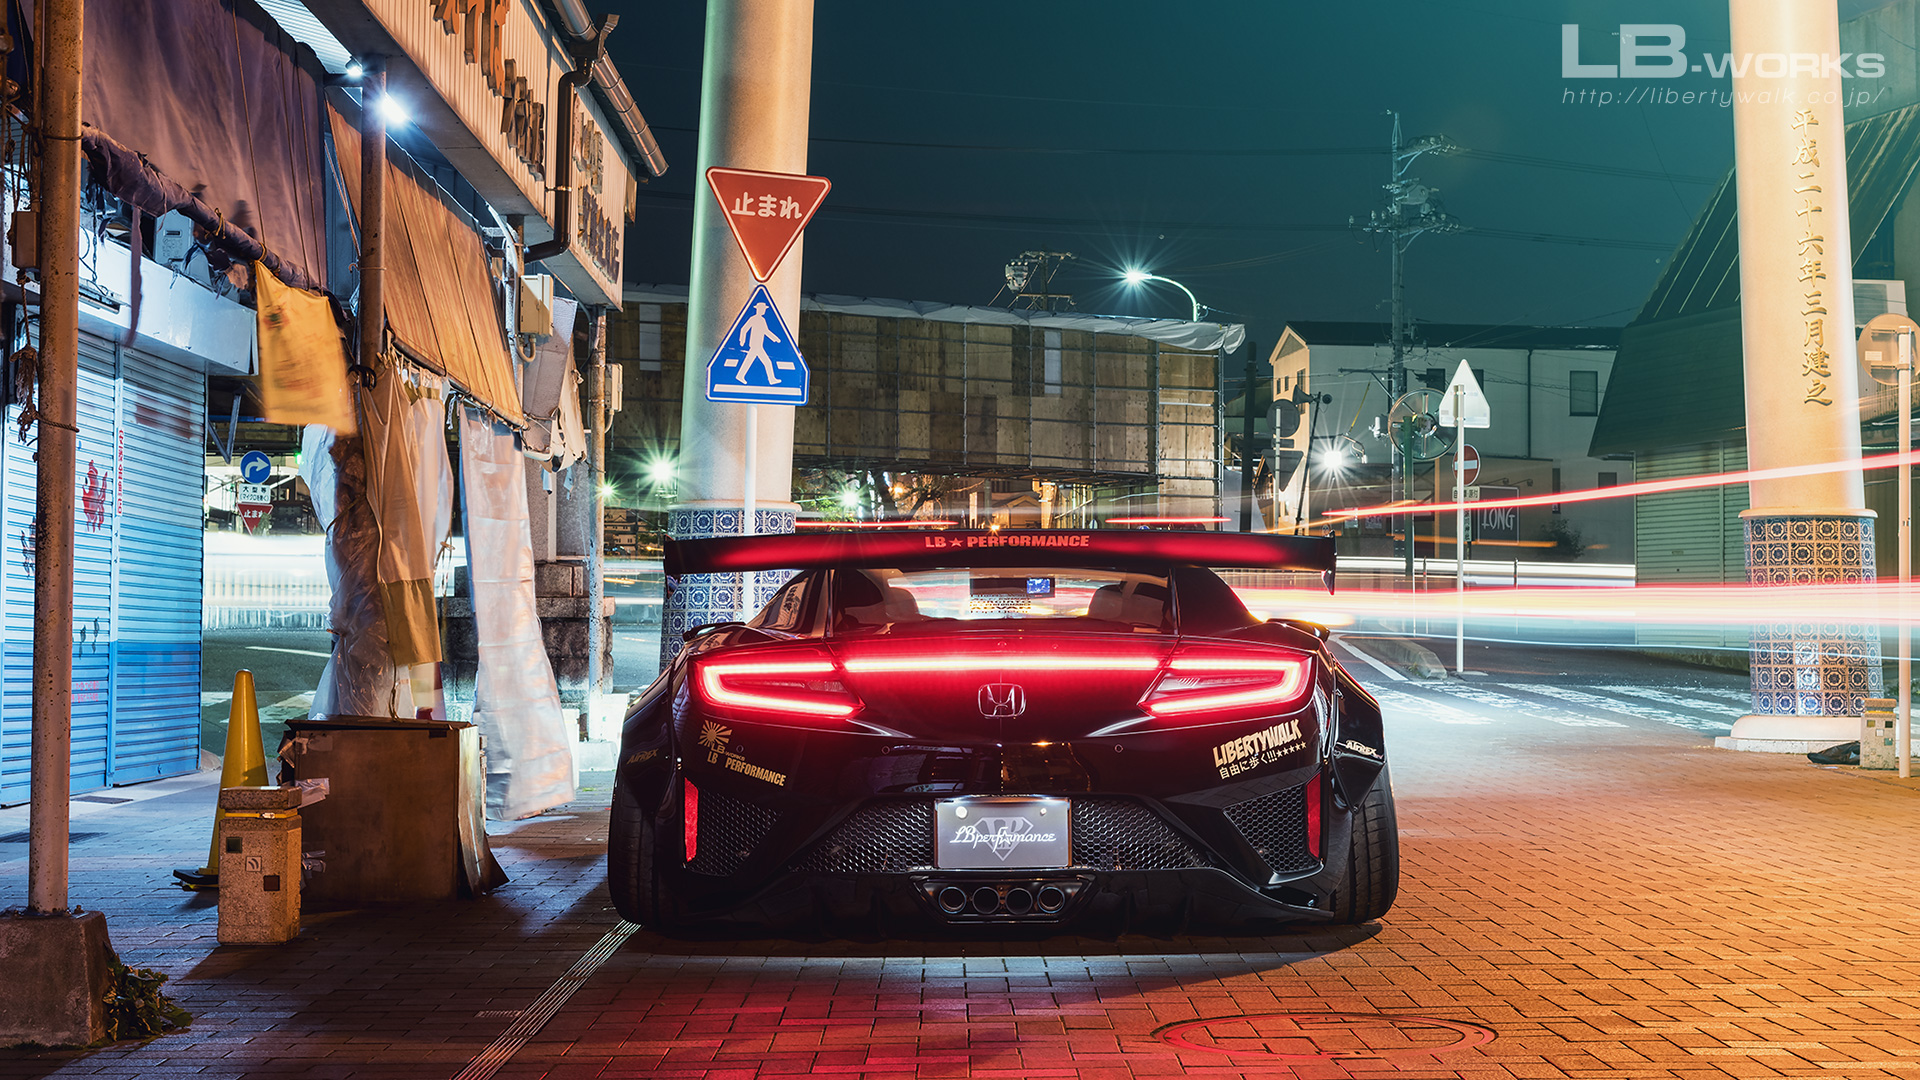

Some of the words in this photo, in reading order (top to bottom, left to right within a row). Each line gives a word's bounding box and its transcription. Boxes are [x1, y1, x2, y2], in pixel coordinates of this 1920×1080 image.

[731, 191, 803, 219] 止まれ
[1791, 109, 1833, 406] 平成二十六年三月建之
[925, 537, 947, 548] LB
[967, 535, 1090, 548] PERFORMANCE
[1212, 719, 1303, 768] LIBERTYWALK
[707, 751, 719, 764] LB
[725, 757, 786, 786] PERFORMANCE
